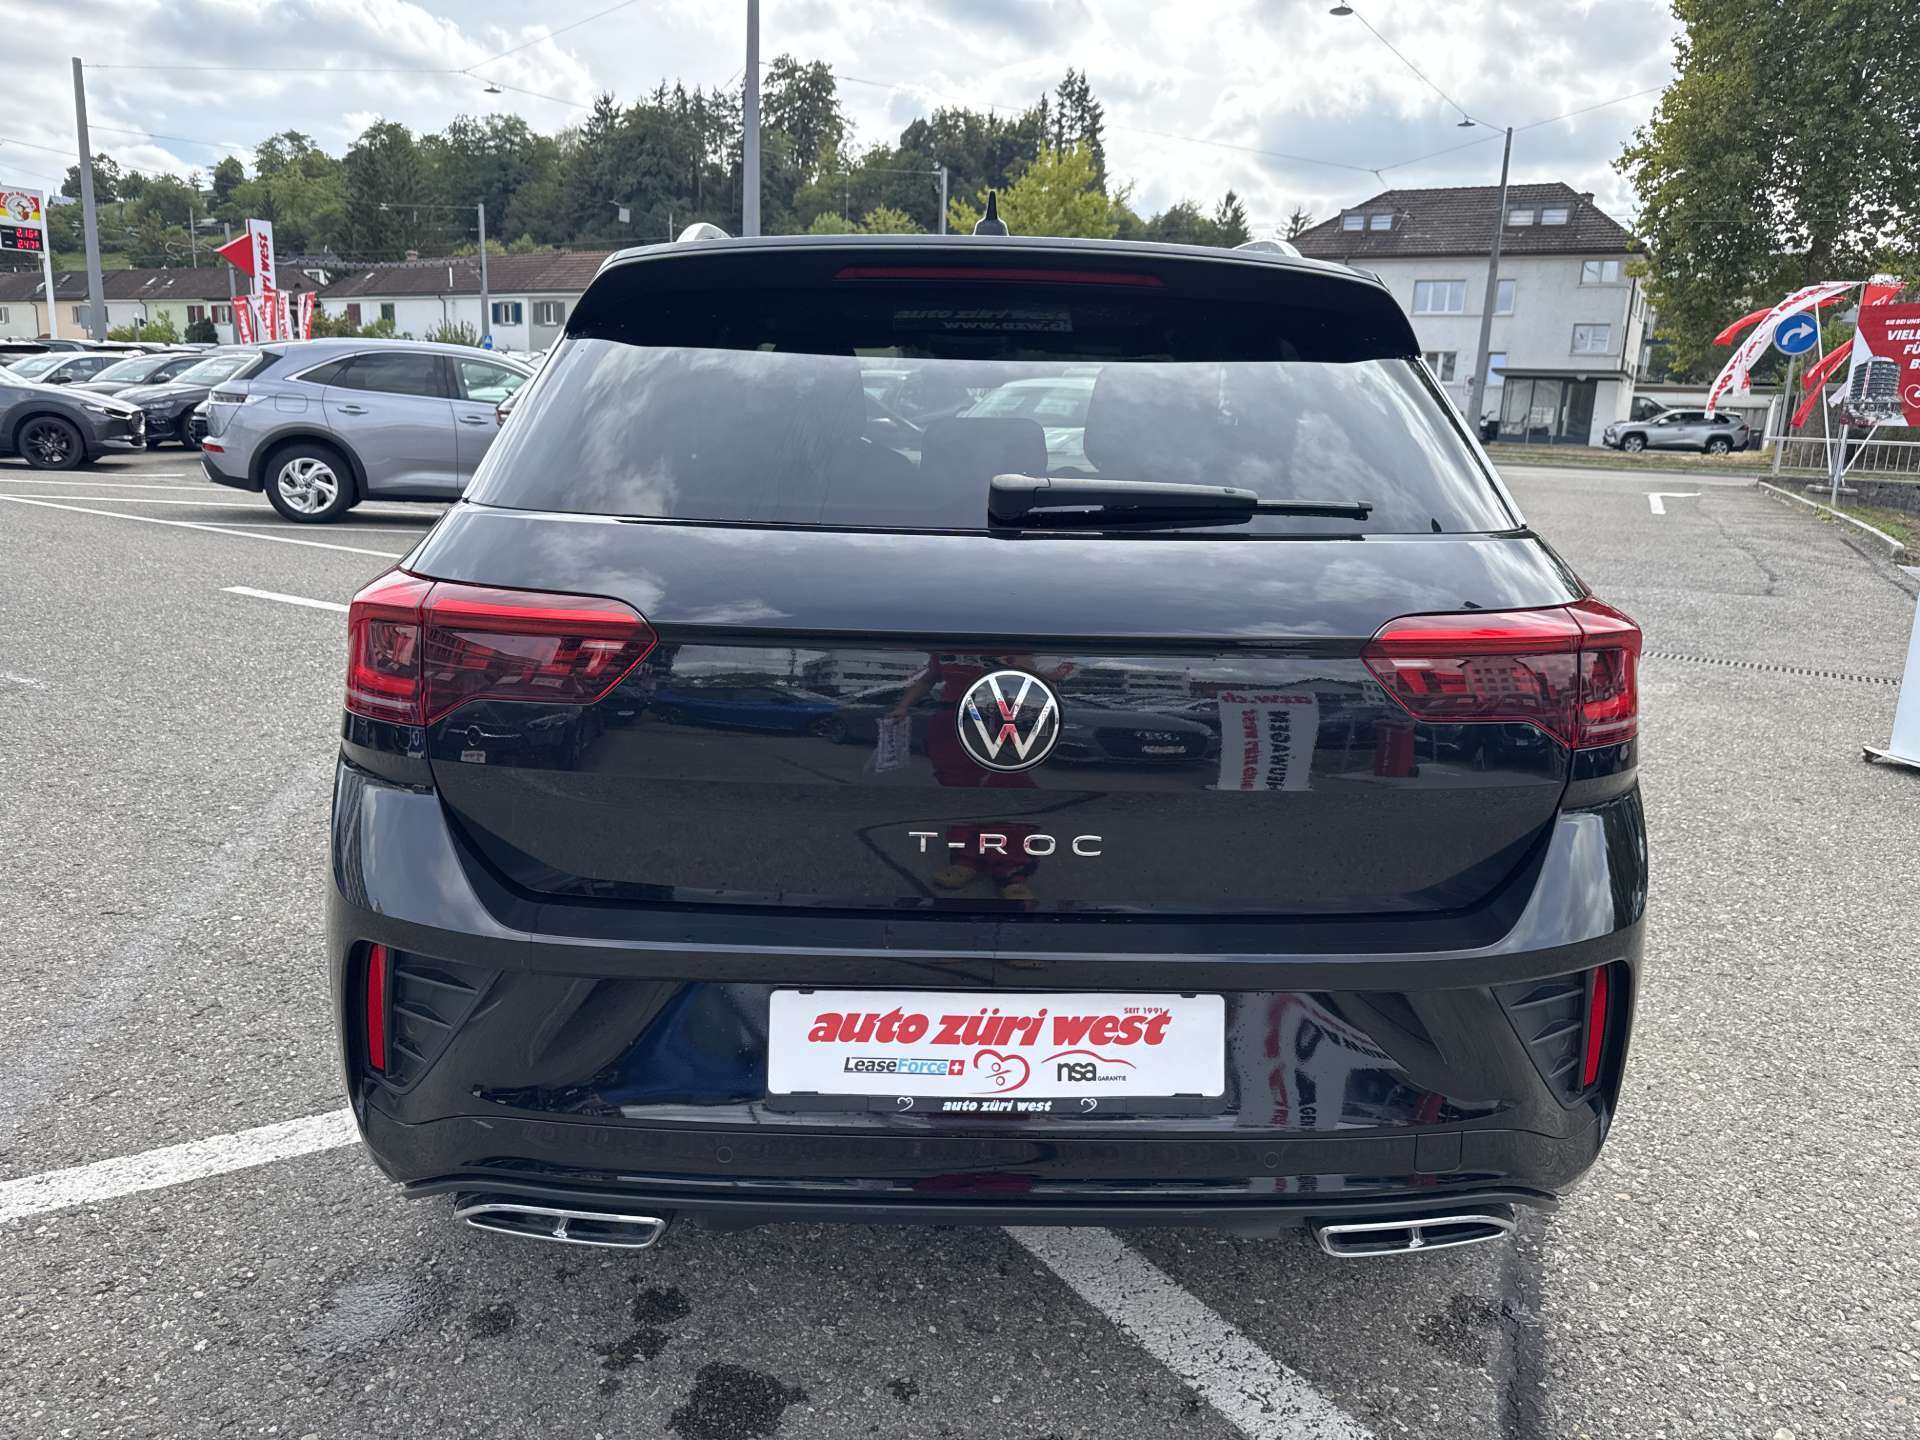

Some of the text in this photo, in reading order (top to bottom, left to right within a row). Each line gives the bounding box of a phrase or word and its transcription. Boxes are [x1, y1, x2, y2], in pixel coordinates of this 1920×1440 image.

[258, 232, 271, 272] west
[908, 831, 1103, 857] T-ROC
[807, 1006, 1173, 1046] auto züri west
[843, 1057, 948, 1075] LeaseForce
[1057, 1062, 1097, 1082] nsa
[942, 1099, 1053, 1112] auto züri west
